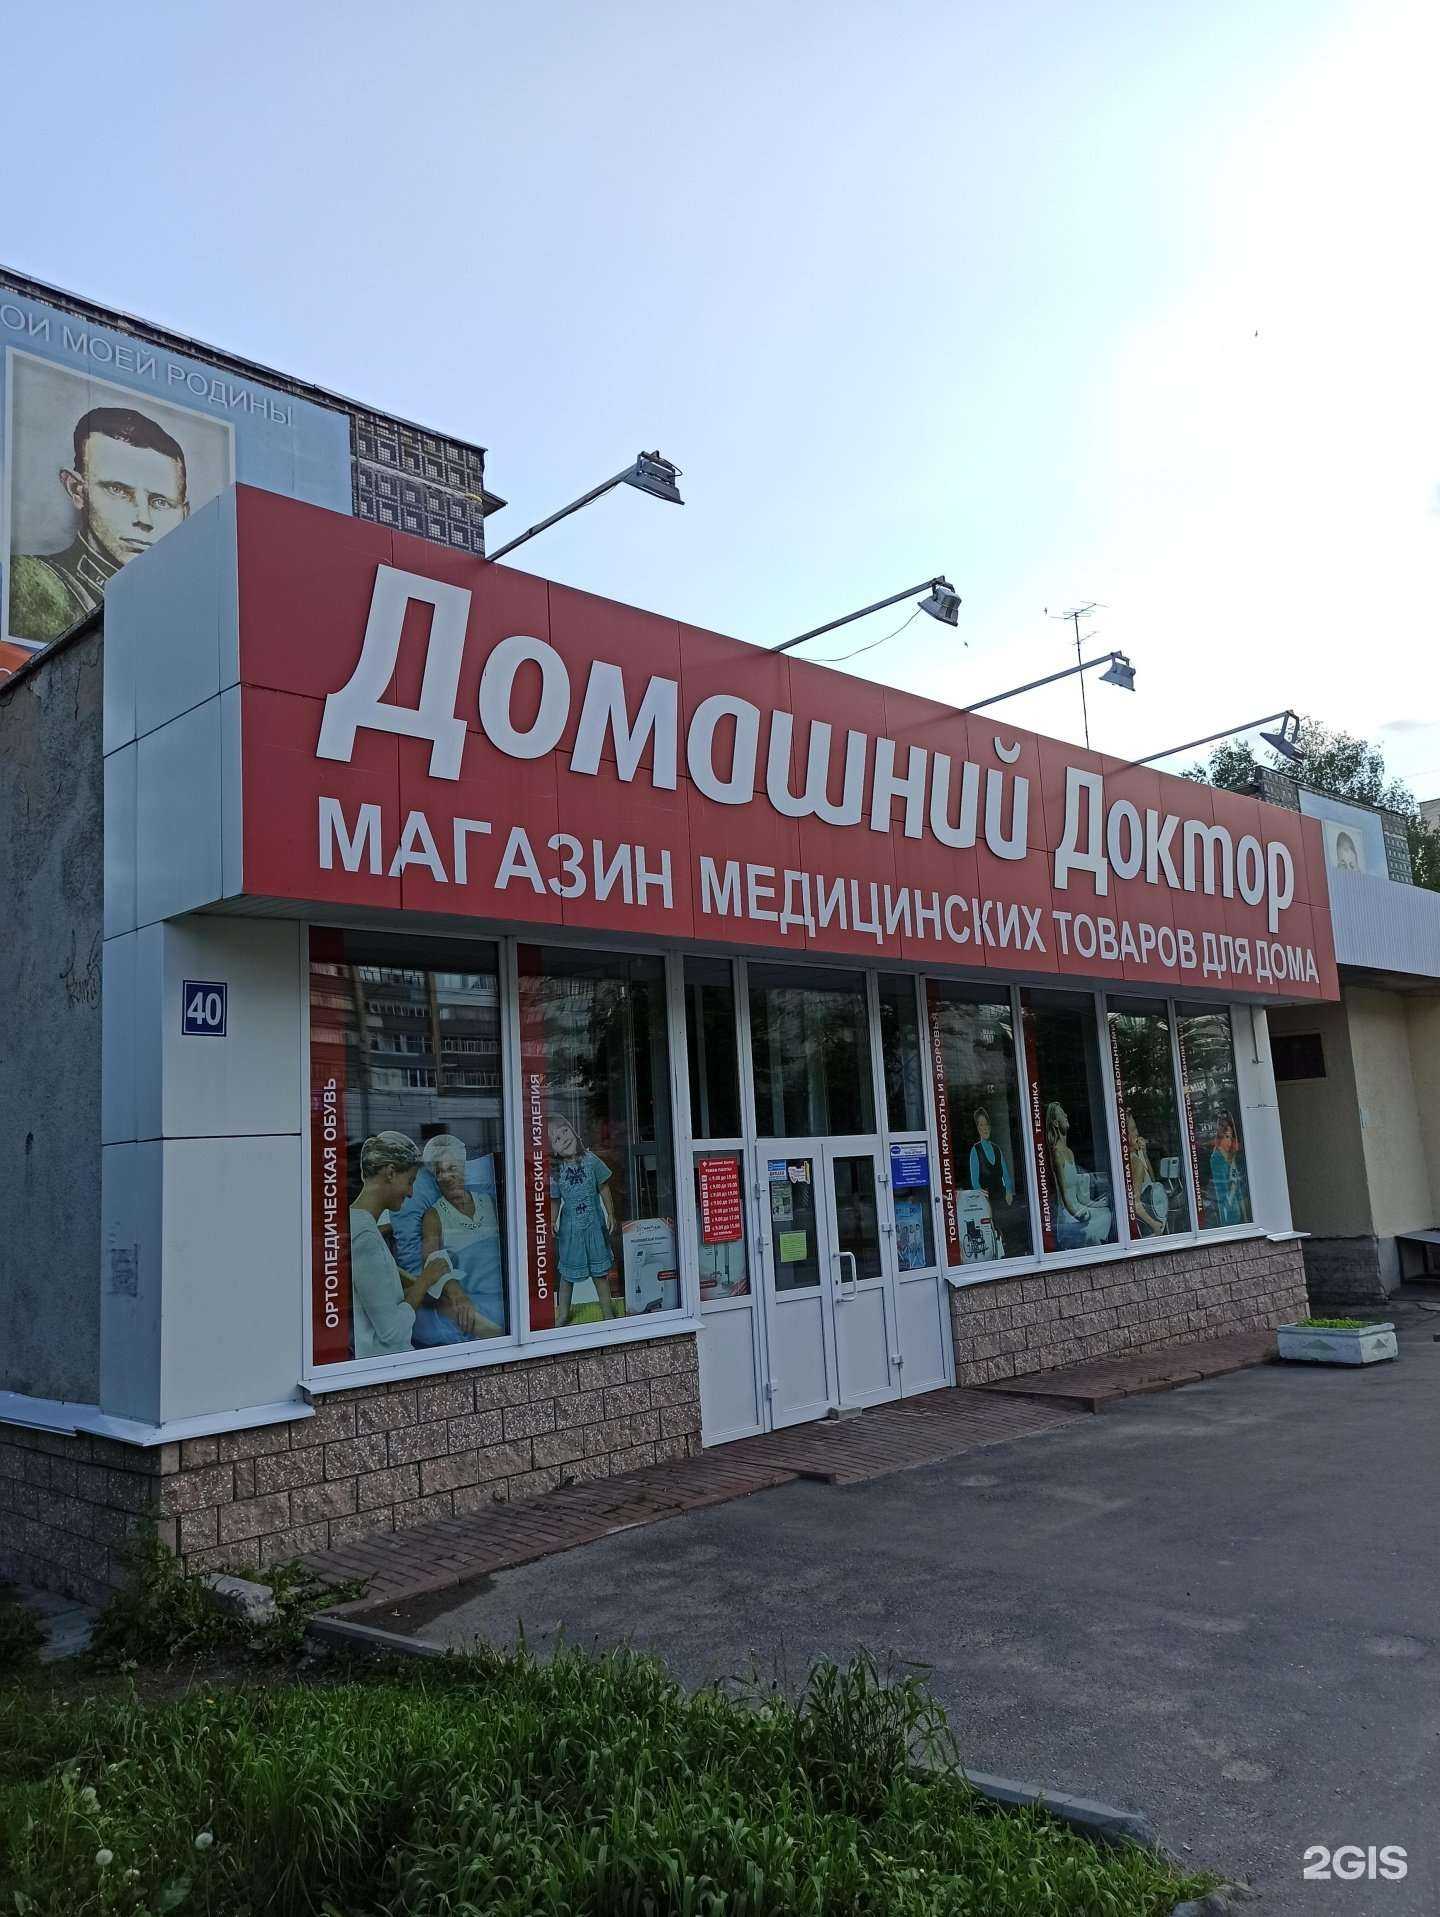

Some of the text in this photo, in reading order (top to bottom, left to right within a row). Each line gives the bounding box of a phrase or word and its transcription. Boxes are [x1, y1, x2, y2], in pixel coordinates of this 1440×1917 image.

[63, 325, 157, 381] МОЕЙ
[167, 362, 293, 428] РОДИНЫ
[316, 564, 1296, 934] Домашний Доктор
[318, 796, 1320, 985] МАГАЗИН МЕДИЦИНСКИХ ТОВАРОВ ДЛЯ ДОМА
[187, 991, 222, 1026] 40
[937, 1083, 945, 1092] И
[938, 1095, 951, 1154] КРАСОТЫ
[530, 1074, 548, 1299] ОРТОПЕДИЧЕСКИЕ ИЗДЕЛИЯ
[943, 1158, 953, 1184] ДЛЯ
[1032, 1081, 1051, 1232] МЕДИЦИНСКАЯ ТЕХНИКА
[1124, 1163, 1136, 1221] СРЕДСТВА
[323, 1078, 339, 1328] ОРТОПЕДИЧЕСКАЯ ОБУВЬ
[945, 1189, 957, 1244] ТОВАРЫ
